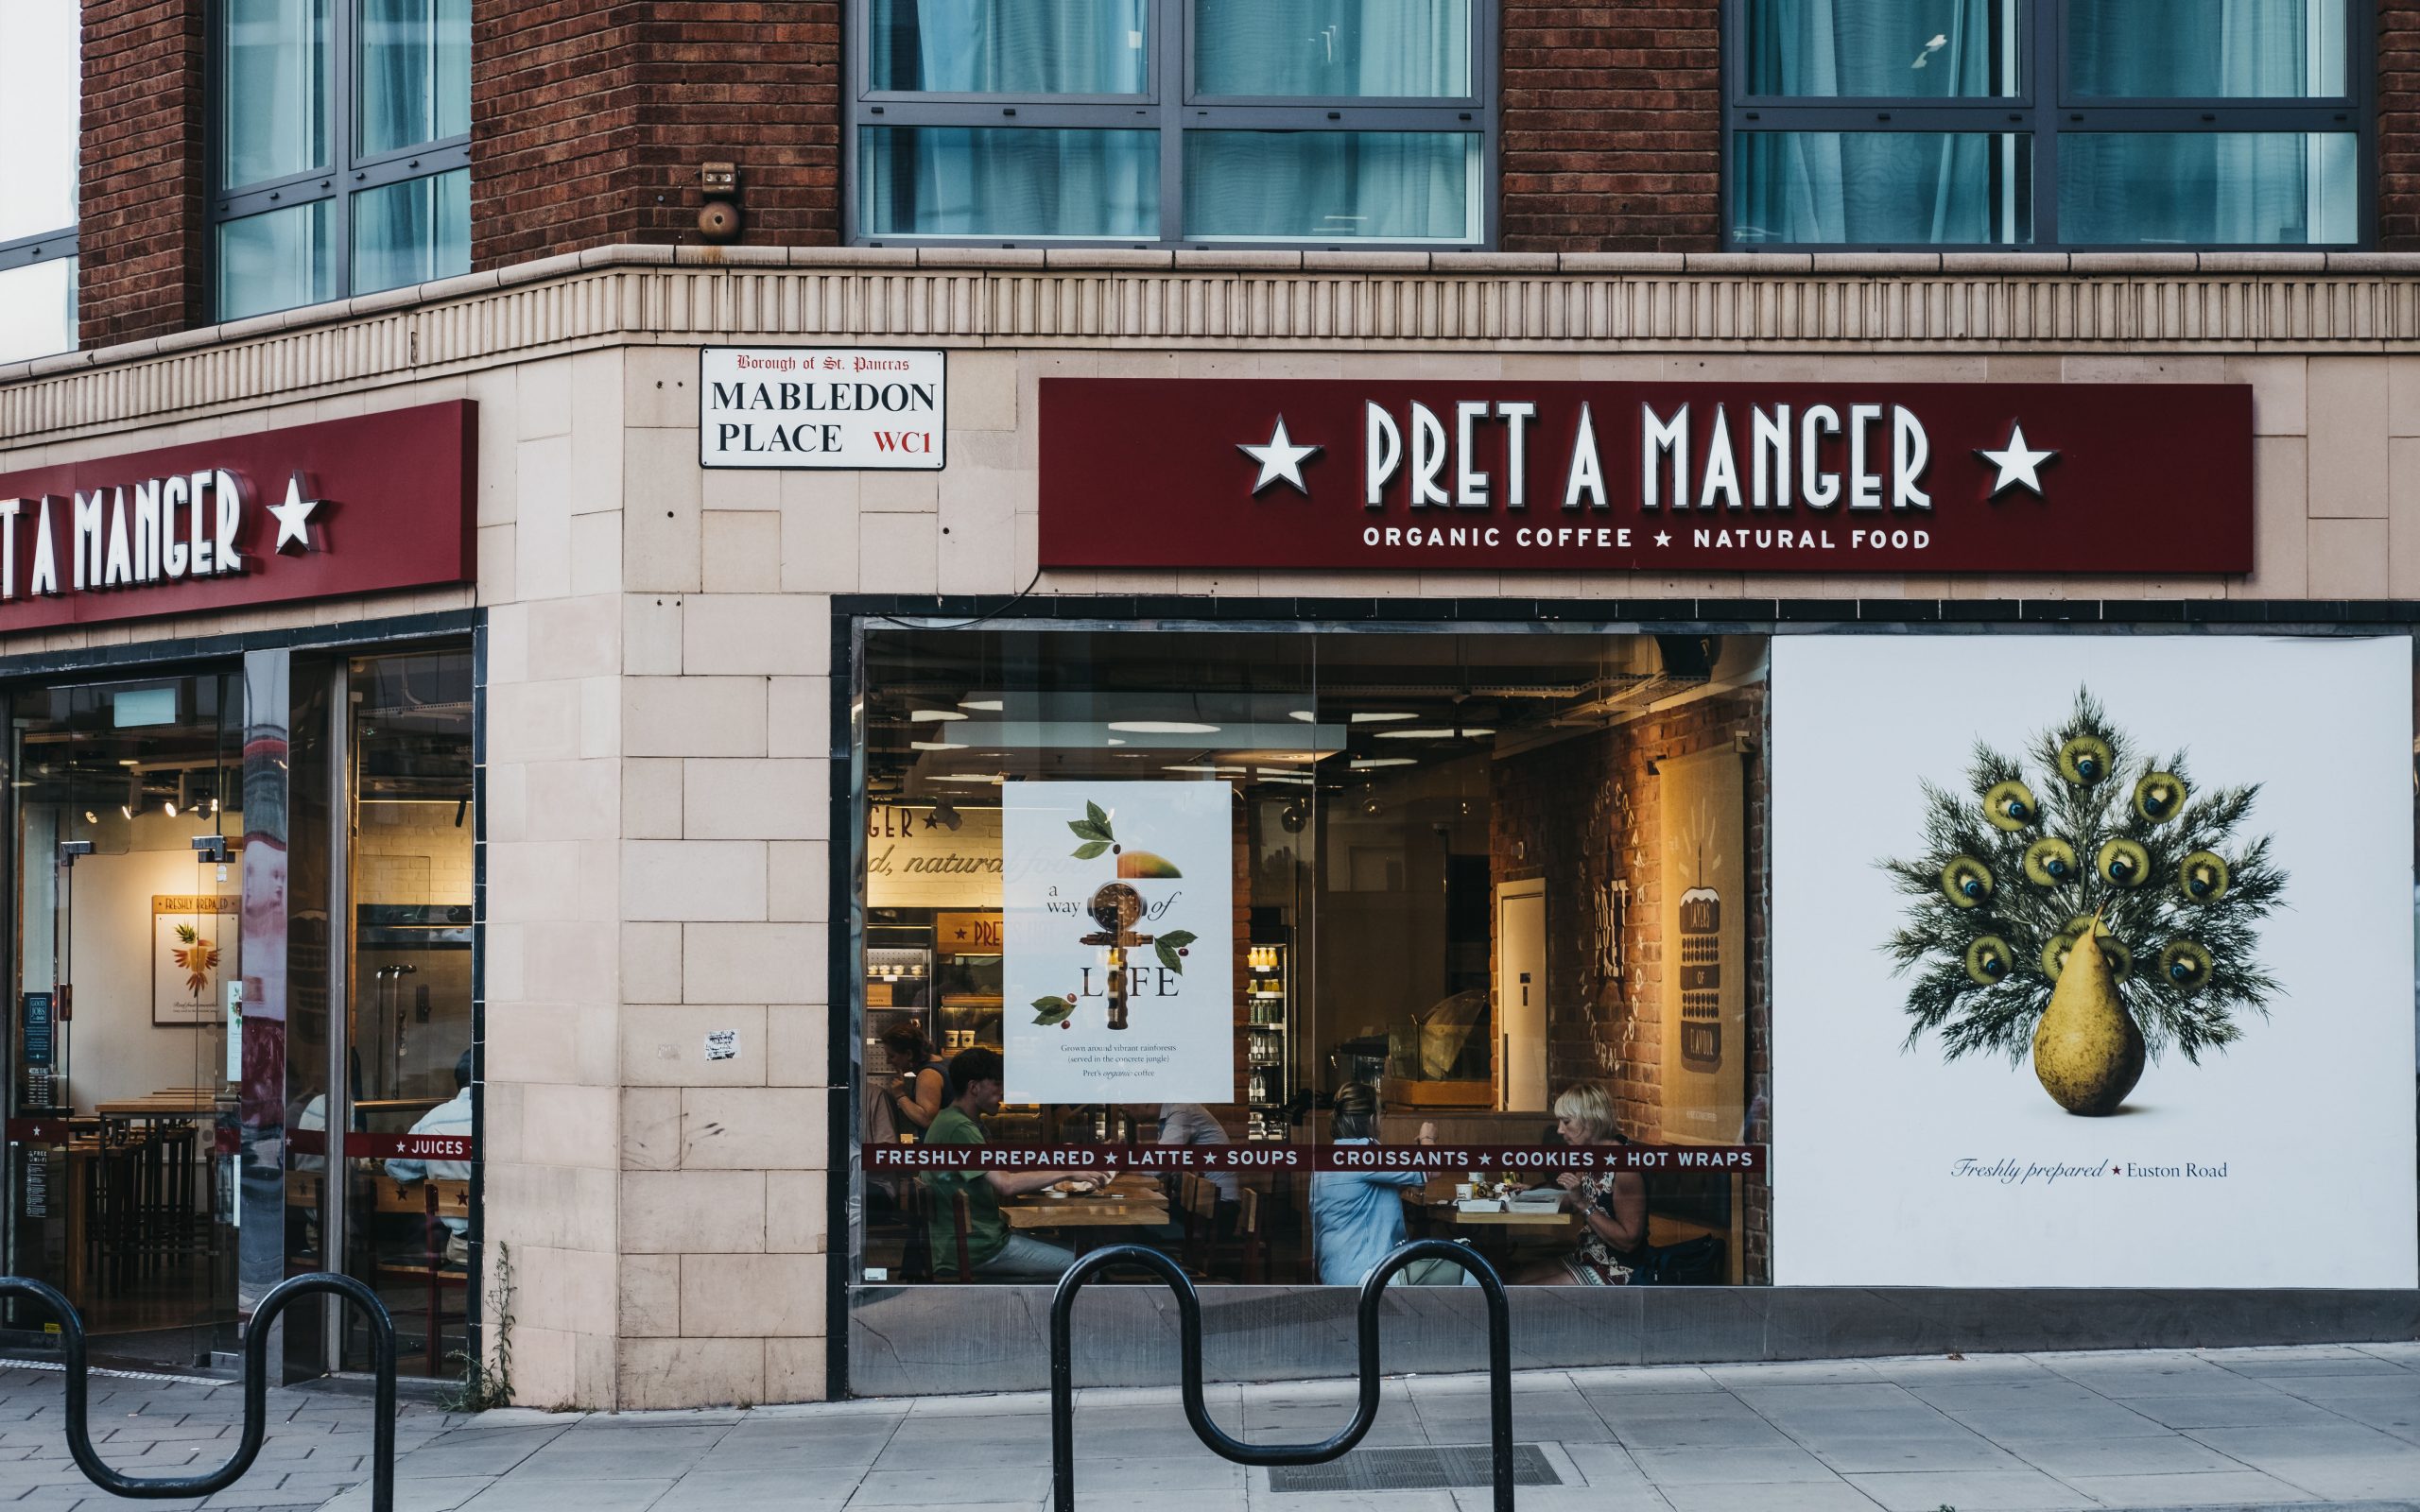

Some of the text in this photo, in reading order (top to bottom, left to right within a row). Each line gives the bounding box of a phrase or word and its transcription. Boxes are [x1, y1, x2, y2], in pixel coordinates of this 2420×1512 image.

[737, 354, 910, 372] Borough of St. Pancras
[711, 381, 936, 412] MABLEDON
[716, 423, 933, 454] PLACE WC1
[1366, 400, 1931, 508] PRET A MANGER
[31, 493, 59, 596] A
[74, 470, 242, 592] MANGER
[1363, 526, 1929, 549] ORGANIC COFFEE NATURAL FOOD
[1048, 885, 1058, 897] a
[165, 898, 192, 910] FRESHLY
[1046, 890, 1183, 922] way of
[1697, 971, 1705, 986] OF
[1114, 1043, 1138, 1052] vibrant
[1140, 1043, 1177, 1052] rainforests
[1102, 1055, 1115, 1063] the
[1133, 1069, 1155, 1077] coffee
[411, 1140, 463, 1155] JUICES
[874, 1149, 1754, 1166] FRESHLY PREPARED LATTE SOUPS CROISSANTS COOKIES HOT WRAPS
[1951, 1159, 2228, 1185] Freshly prepared Euston Road
